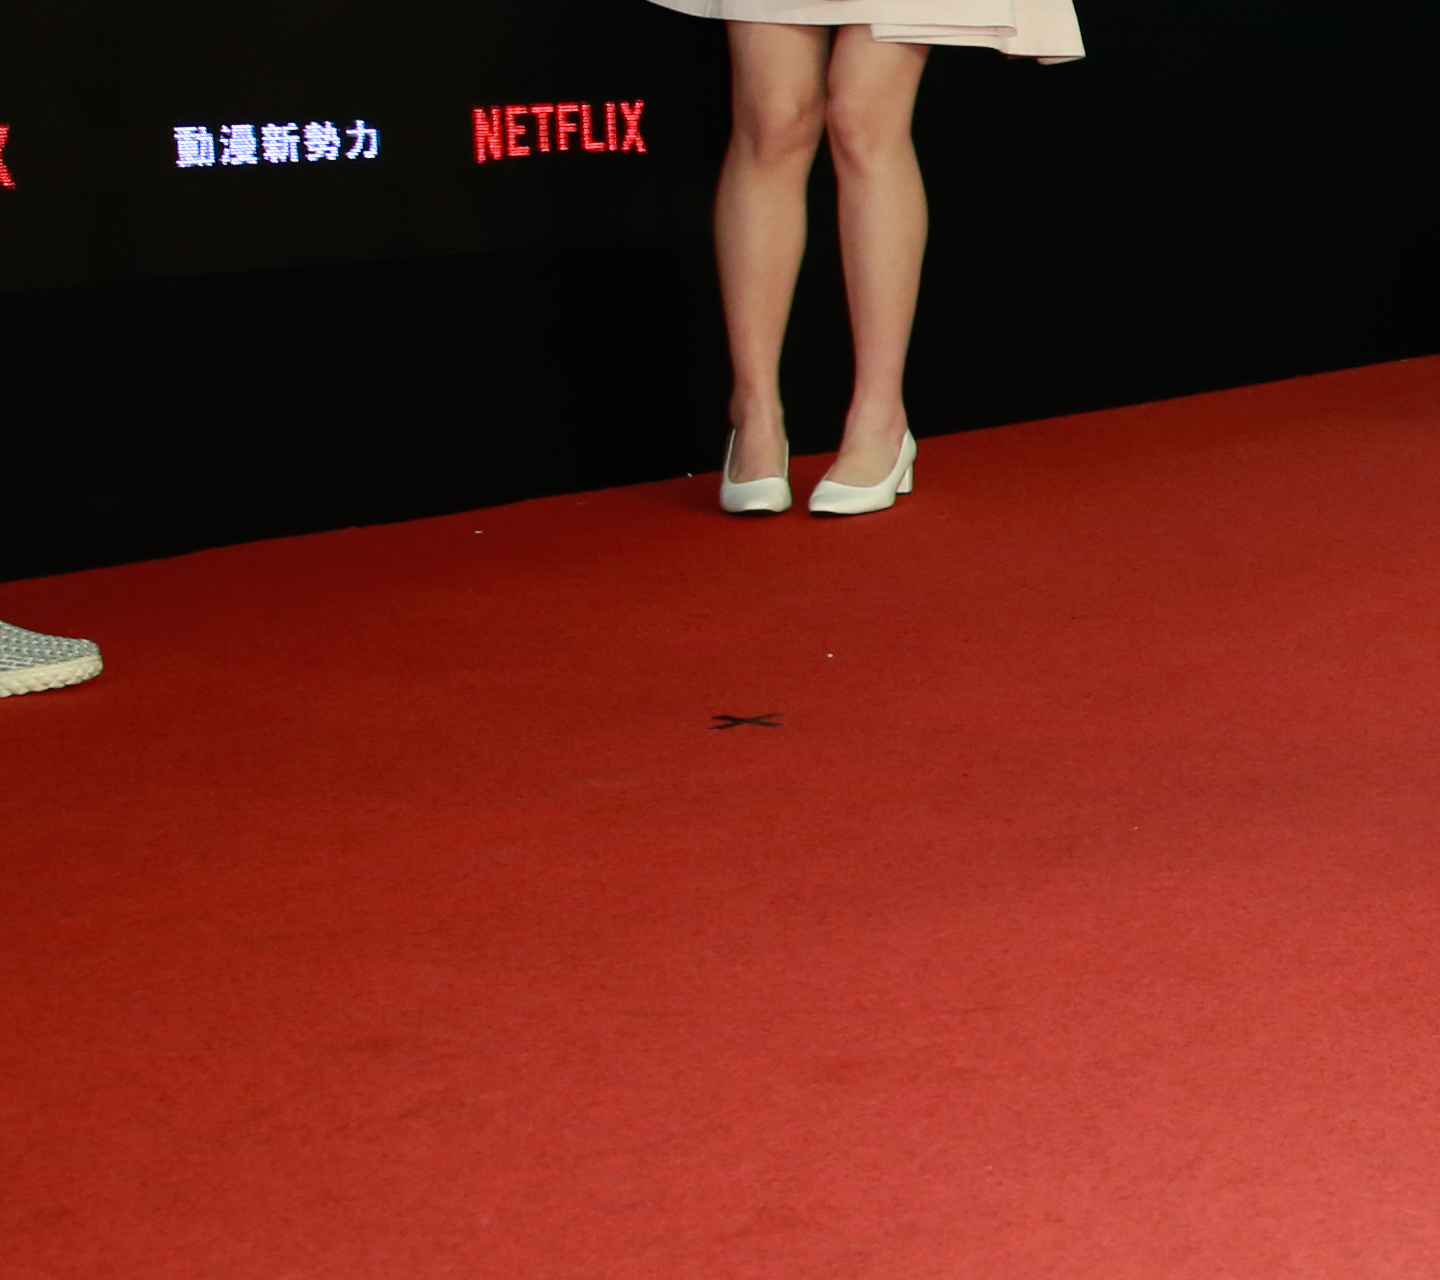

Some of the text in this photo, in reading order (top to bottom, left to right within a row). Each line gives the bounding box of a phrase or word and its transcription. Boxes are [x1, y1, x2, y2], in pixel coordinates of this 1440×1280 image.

[174, 120, 379, 167] 動漫新勢力
[472, 99, 647, 164] NETFLIX
